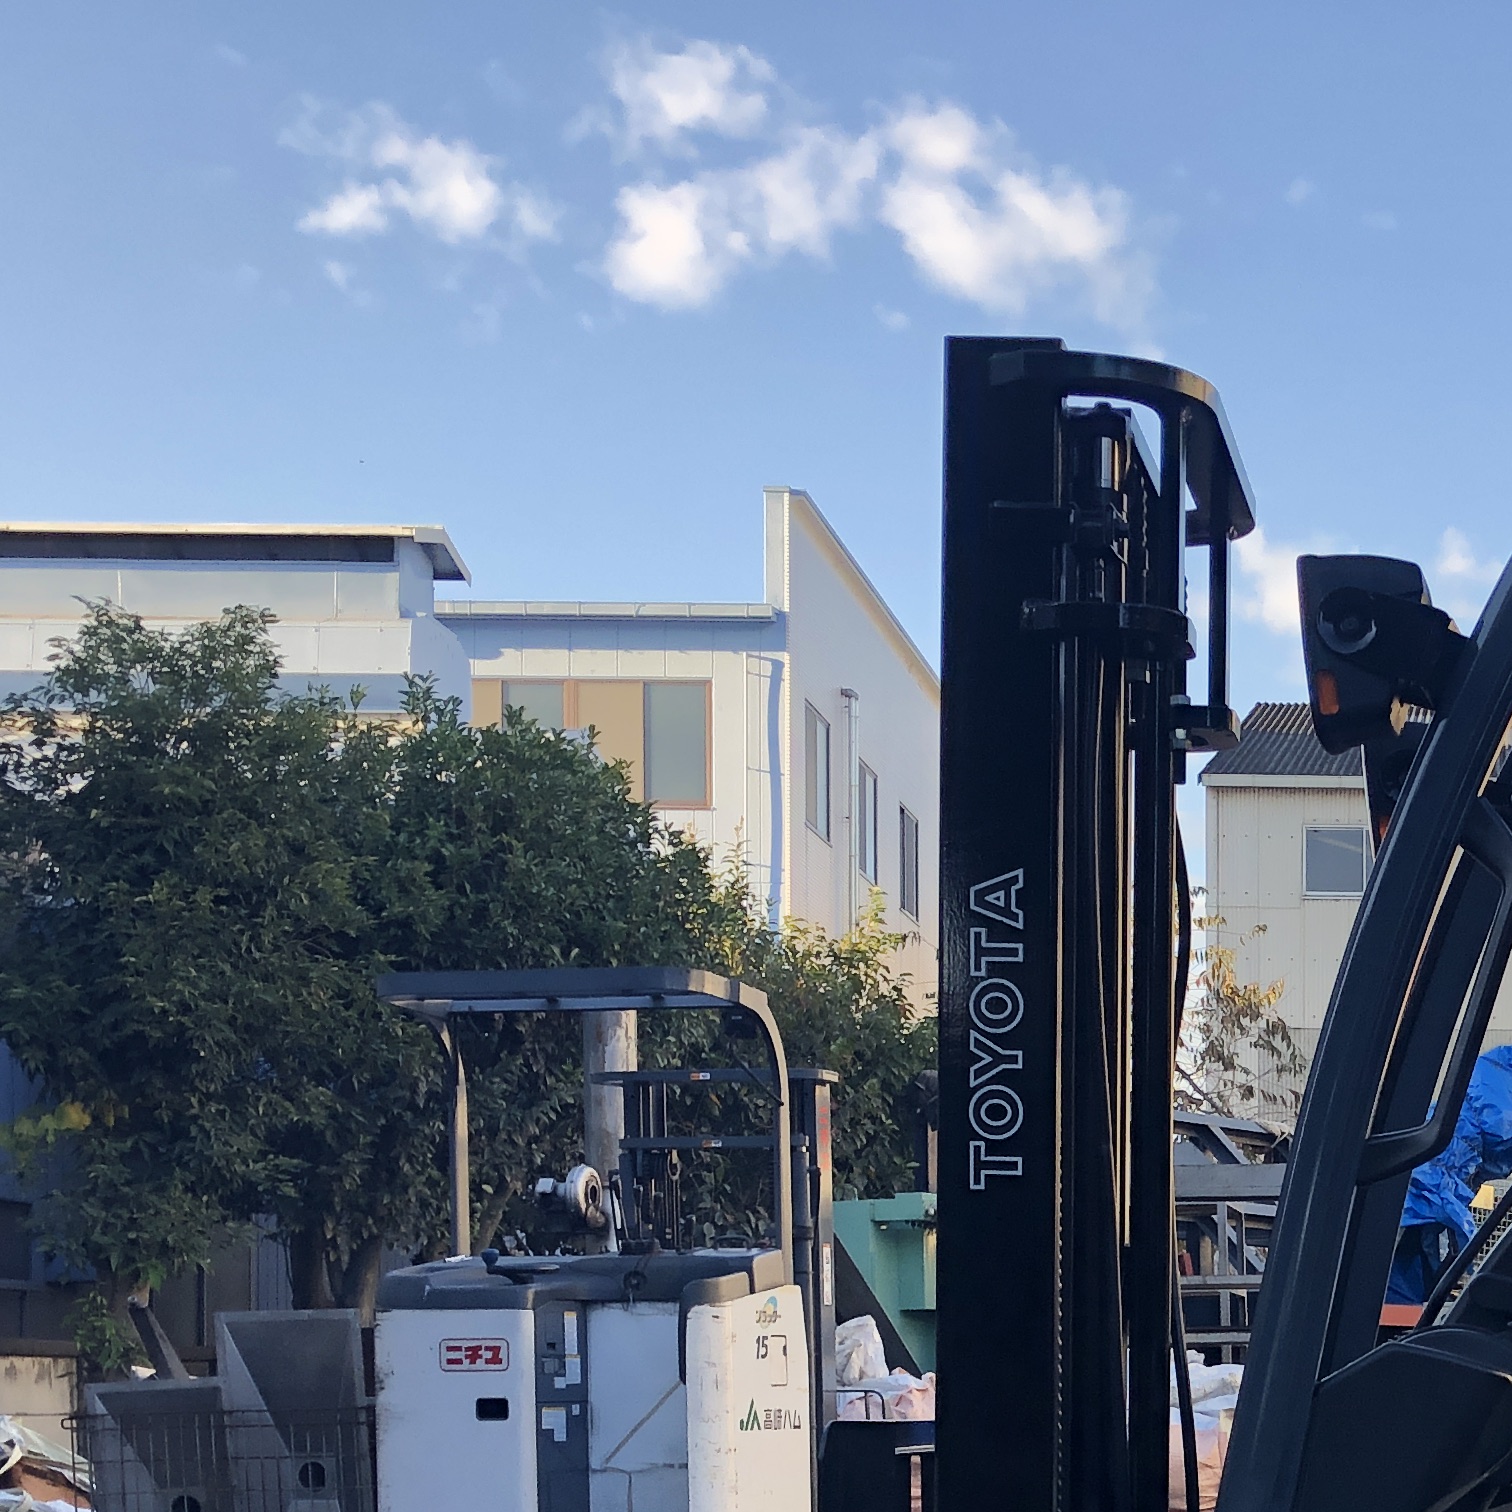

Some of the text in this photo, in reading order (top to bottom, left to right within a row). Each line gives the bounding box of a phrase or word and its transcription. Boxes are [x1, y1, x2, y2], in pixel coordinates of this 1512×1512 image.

[969, 868, 1024, 1190] TOYOTA
[446, 1345, 503, 1365] ニチユ
